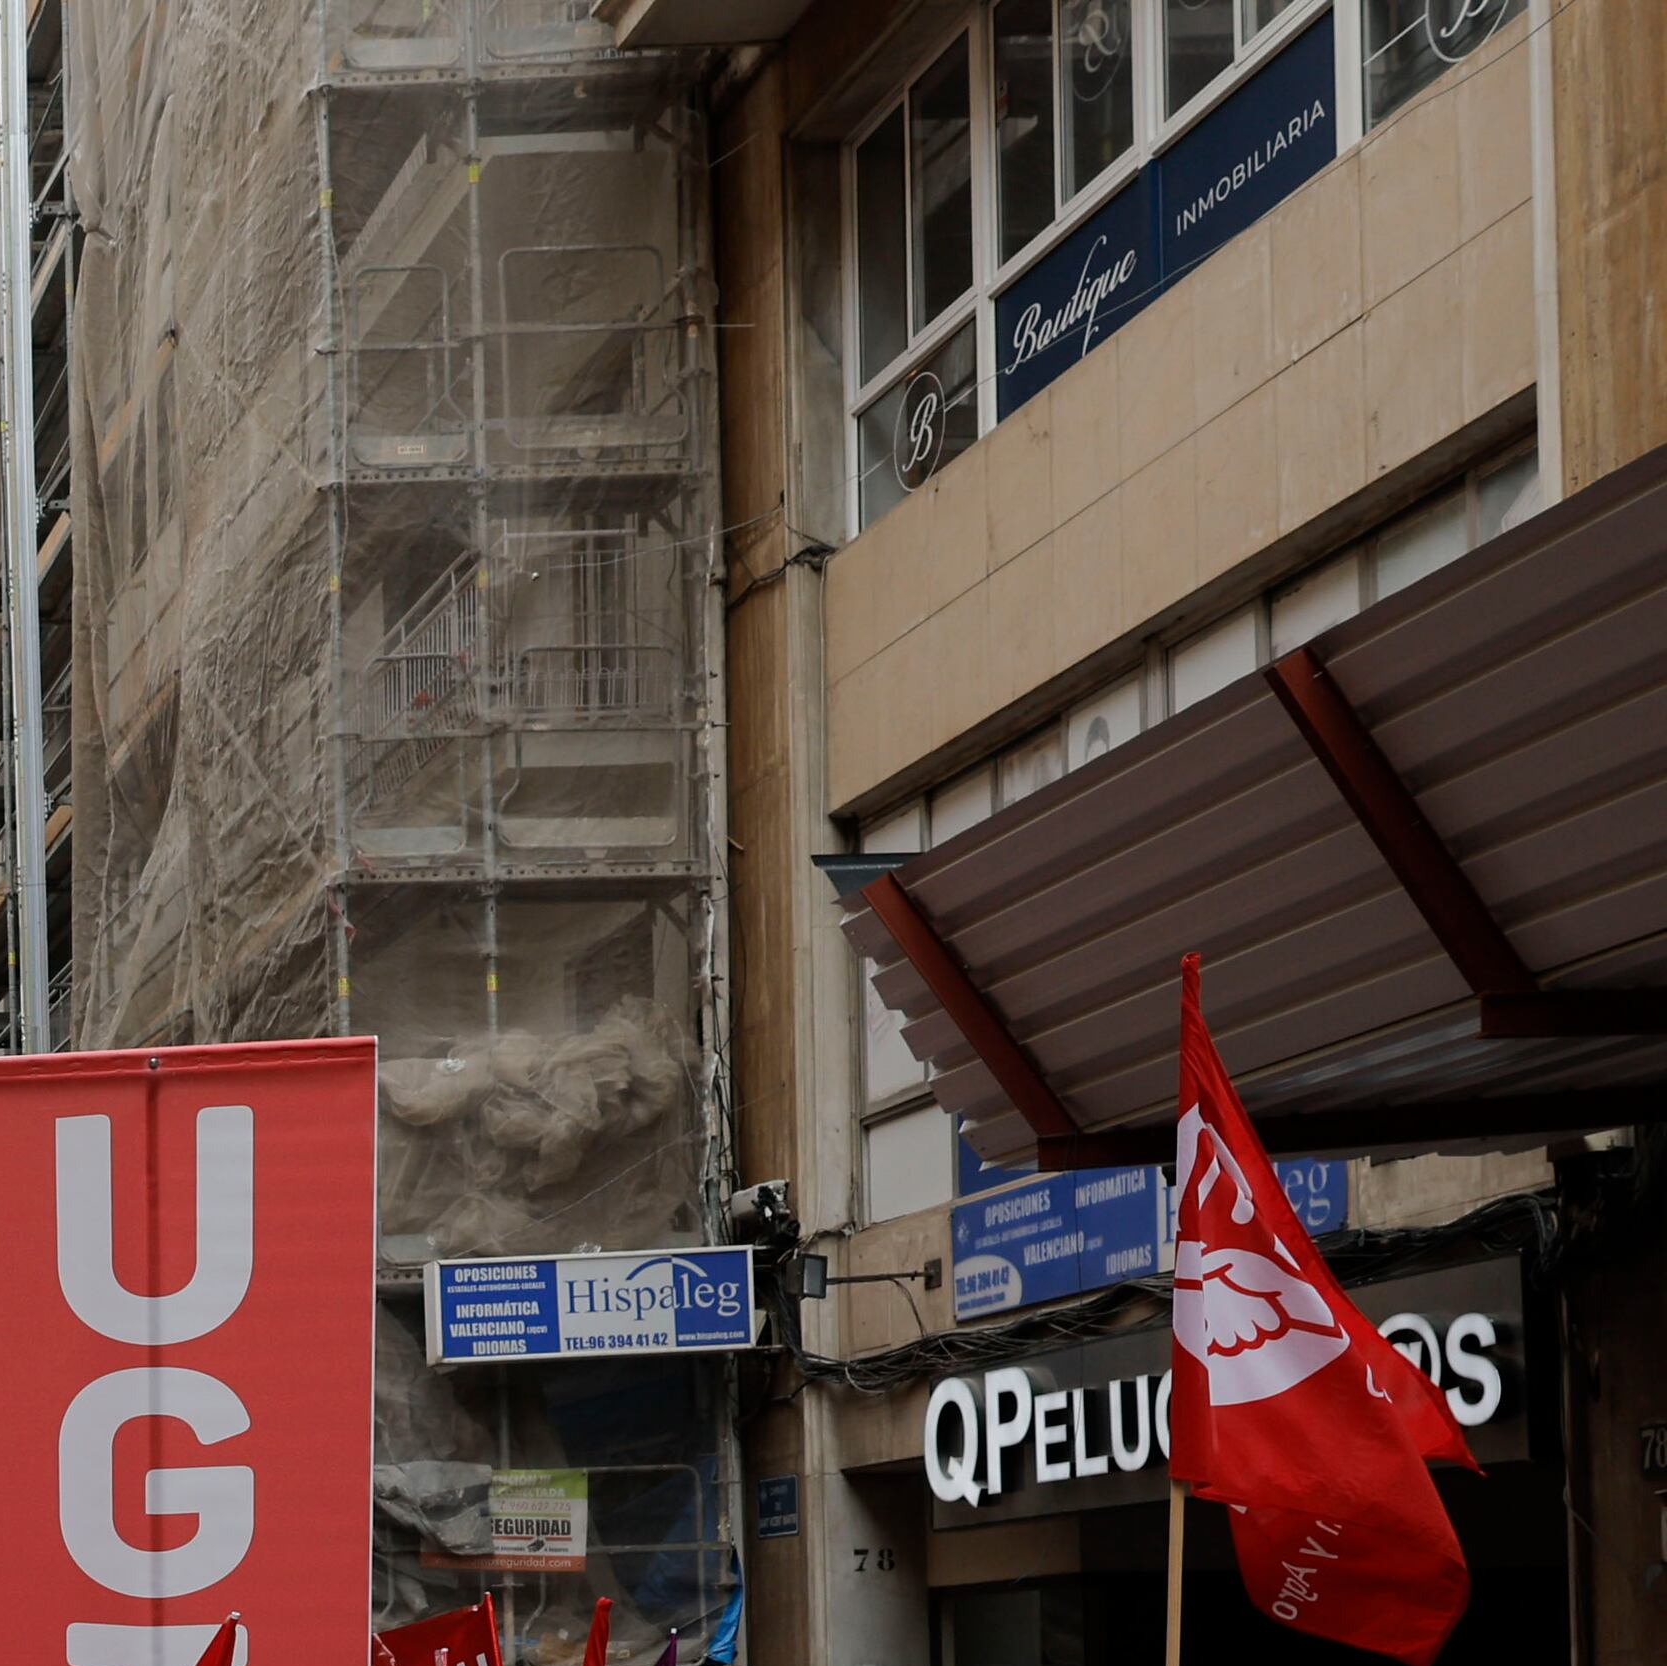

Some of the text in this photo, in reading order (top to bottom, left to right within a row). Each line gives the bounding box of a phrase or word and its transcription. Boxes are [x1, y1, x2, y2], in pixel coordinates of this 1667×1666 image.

[1175, 98, 1327, 237] INMOBILIARIA
[1006, 235, 1137, 374] Boutique
[984, 1188, 1051, 1228] OPOSICIONES
[1023, 1230, 1085, 1267] VALENCIANO
[1105, 1245, 1152, 1276] IDIOMAS
[454, 1264, 537, 1283] OPOSICIONES
[456, 1299, 539, 1319] INFORMÁTICA
[565, 1273, 740, 1321] Hispaleg
[450, 1320, 525, 1338] VALENCIANO
[652, 1332, 668, 1347] 42
[472, 1338, 527, 1356] IDIOMAS
[853, 1548, 895, 1572] 78
